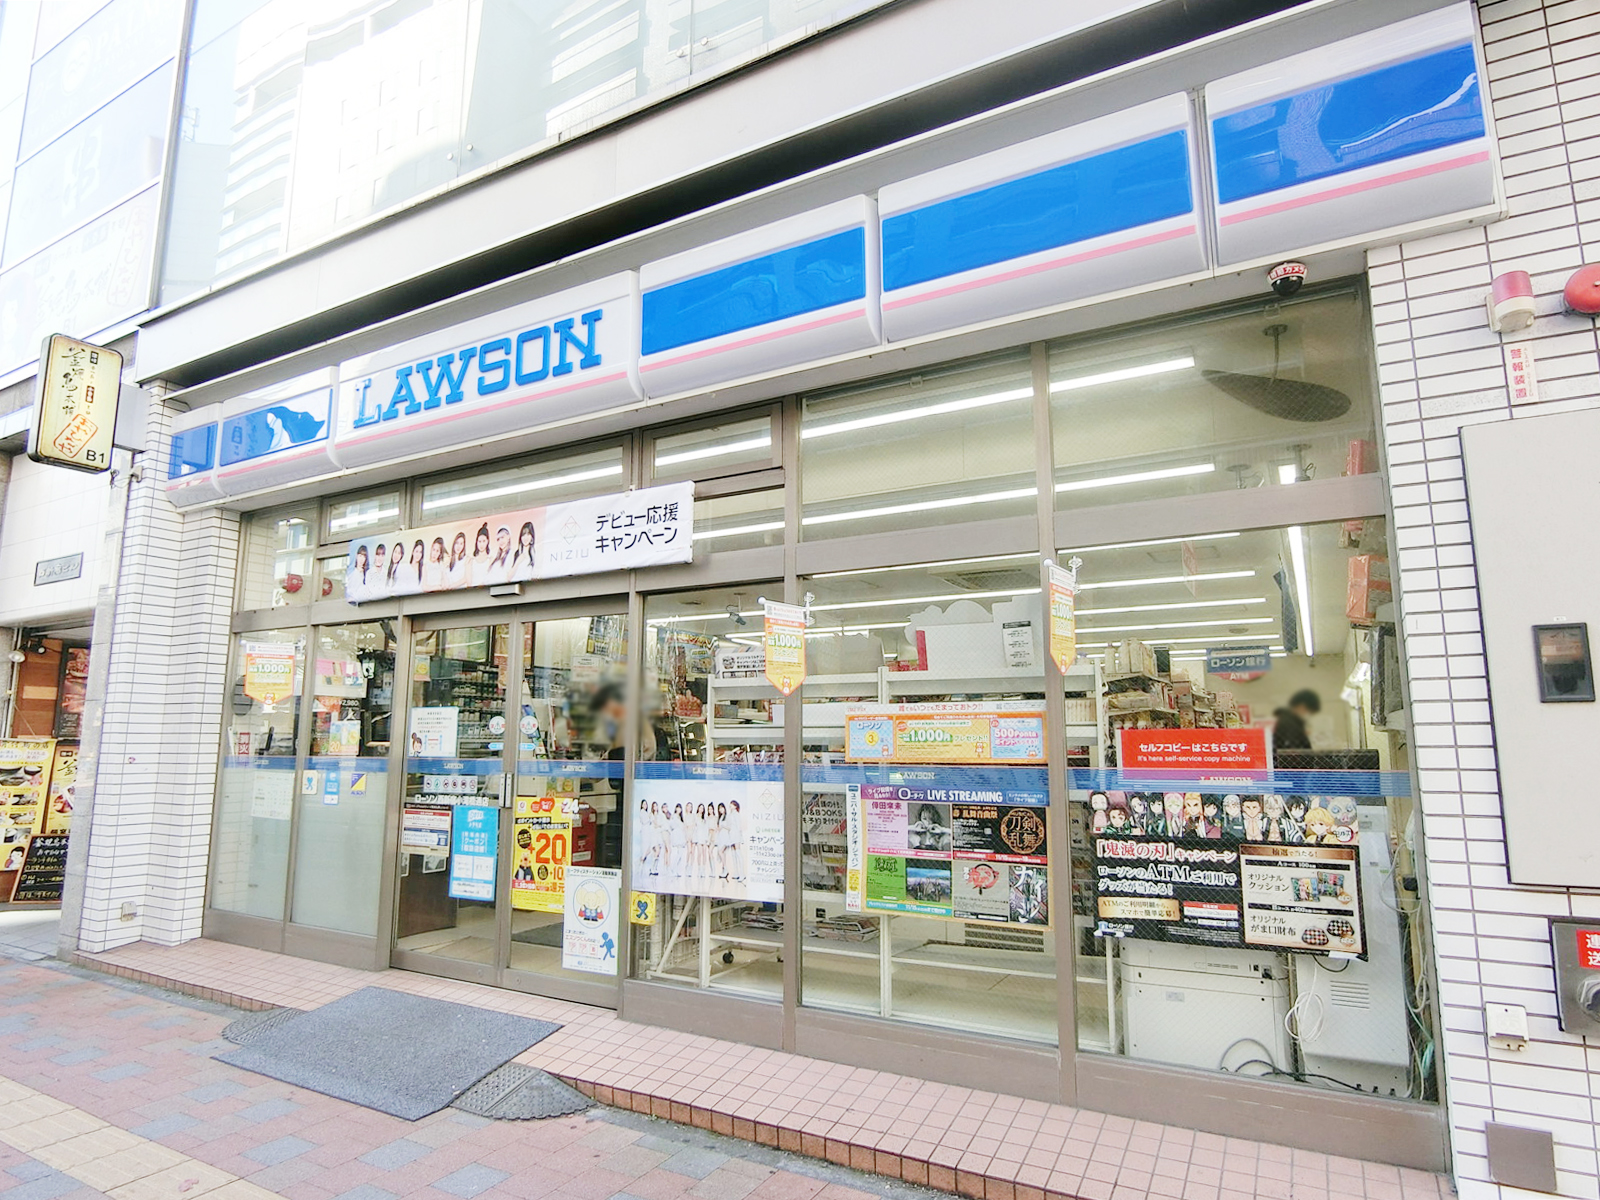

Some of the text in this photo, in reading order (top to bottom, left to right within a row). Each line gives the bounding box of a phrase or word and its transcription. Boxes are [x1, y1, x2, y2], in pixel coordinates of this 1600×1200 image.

[353, 308, 604, 430] LAWSON
[86, 449, 106, 463] B1
[595, 502, 679, 532] デビュー応援
[595, 526, 679, 554] キャンペーン
[550, 548, 590, 562] NIZIU
[1138, 743, 1248, 753] セルフコピーはこちらです
[1165, 755, 1202, 763] self-service
[927, 790, 1003, 804] LIVE STREAMING
[1009, 816, 1037, 832] 刀剣
[1008, 832, 1037, 848] 乱舞
[1271, 847, 1318, 858] 抽選で当たる!
[1097, 864, 1238, 885] ローソンのATMご利用で
[1247, 873, 1285, 882] オリジナル
[1097, 879, 1174, 896] グッズが当たる!
[1248, 882, 1291, 892] クッション
[1249, 915, 1287, 925] オリジナル
[1250, 924, 1297, 936] がま口財布
